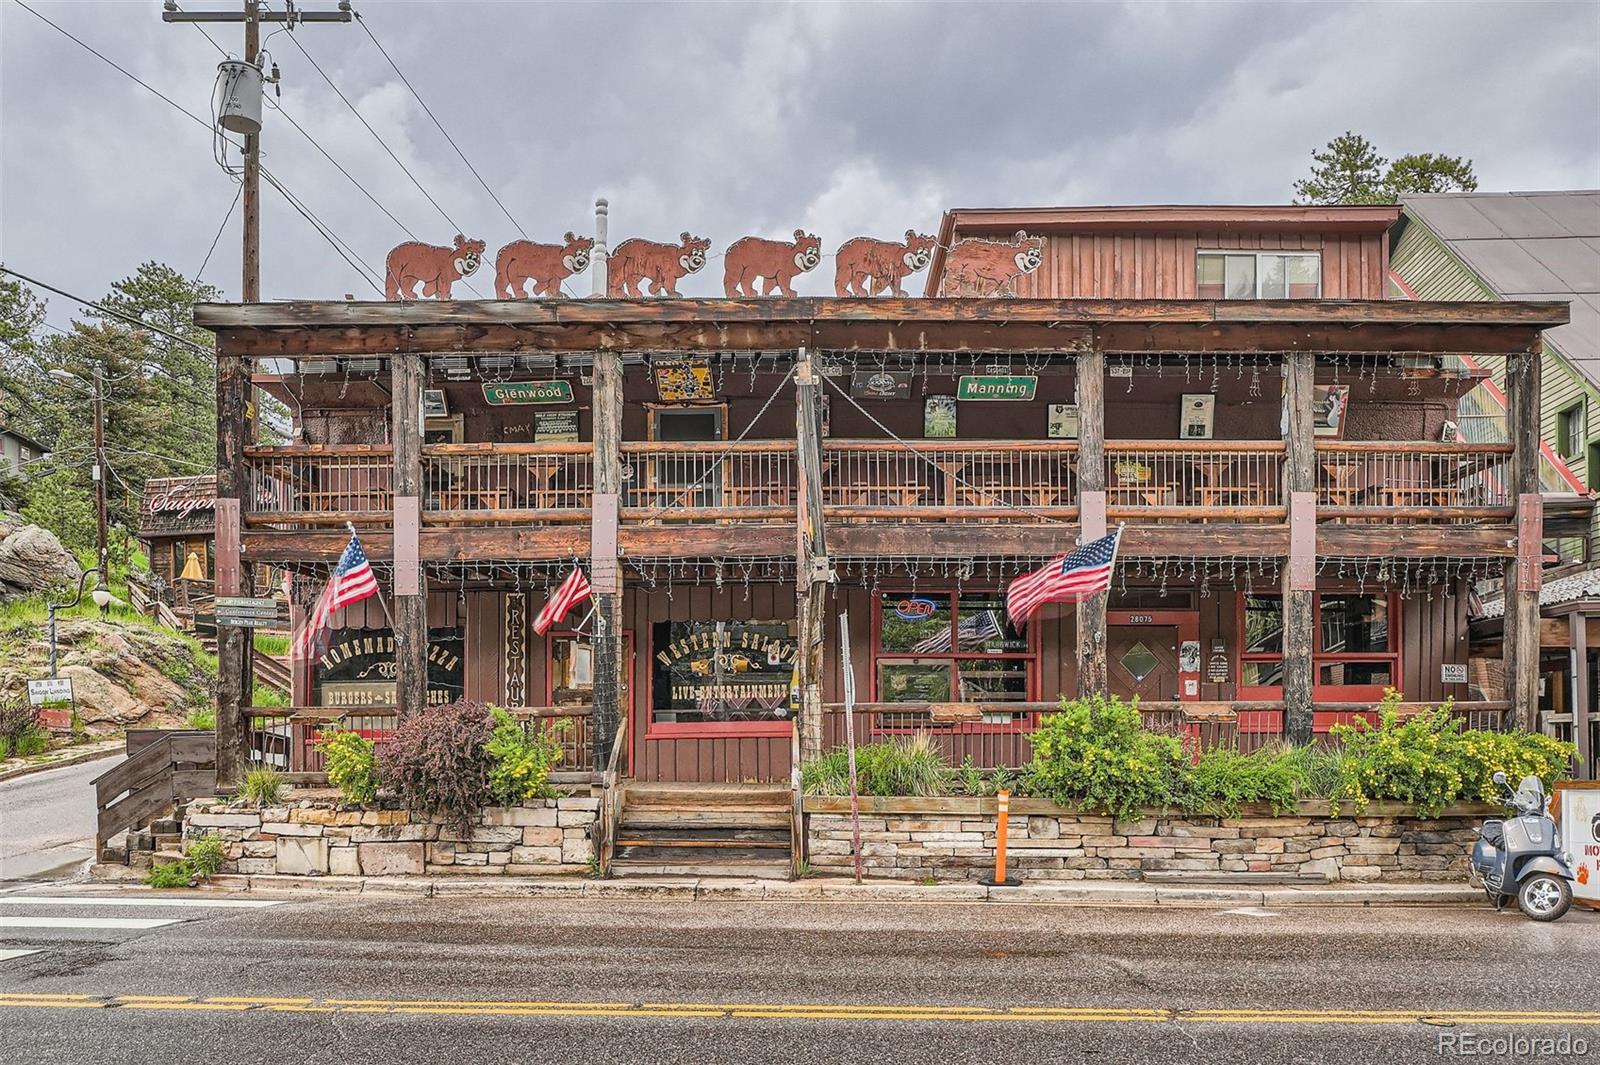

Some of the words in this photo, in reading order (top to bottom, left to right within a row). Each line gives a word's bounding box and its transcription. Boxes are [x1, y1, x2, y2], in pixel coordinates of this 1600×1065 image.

[495, 387, 562, 399] Glenwood
[967, 382, 1027, 396] Manning
[897, 599, 936, 617] OPEN
[1130, 615, 1153, 623] 28075
[320, 636, 394, 671] HOMEMAD
[656, 632, 731, 667] WESTERN
[741, 632, 798, 665] SALOON
[328, 690, 373, 705] BURGERS
[672, 684, 695, 700] LIVE
[699, 684, 789, 700] ENTERTAINMENT
